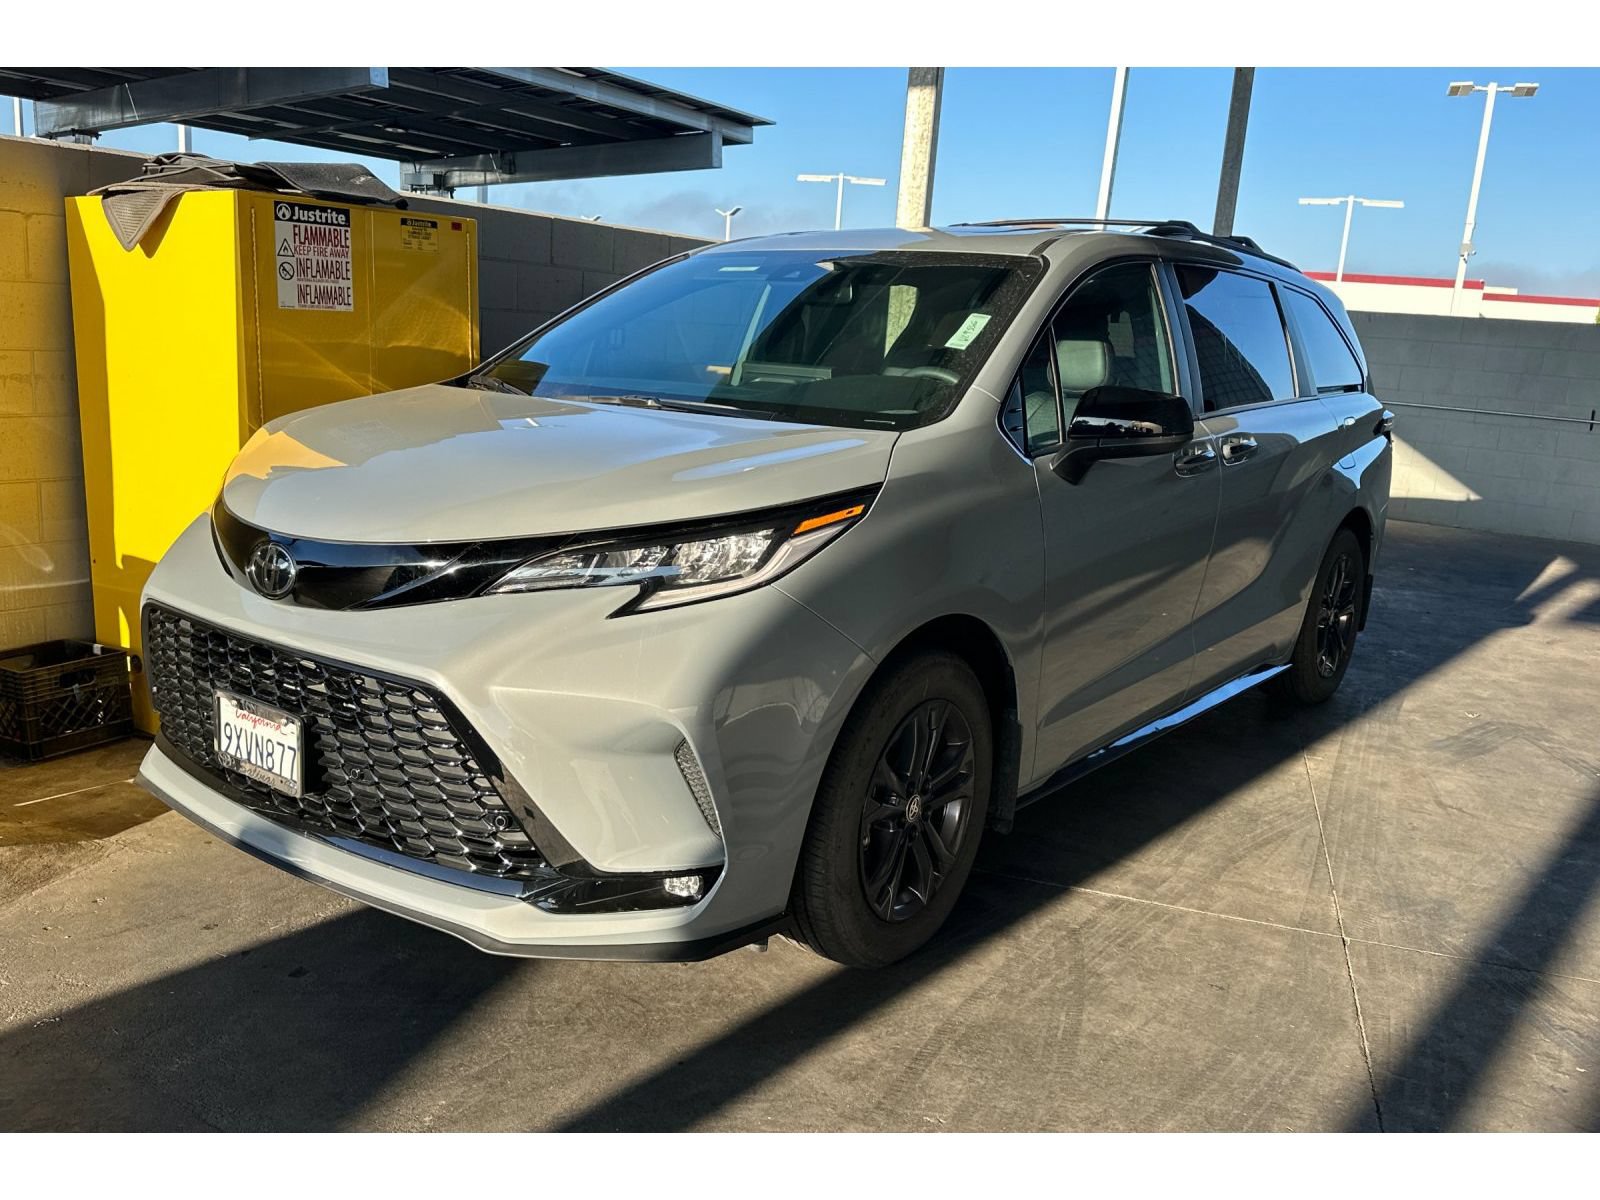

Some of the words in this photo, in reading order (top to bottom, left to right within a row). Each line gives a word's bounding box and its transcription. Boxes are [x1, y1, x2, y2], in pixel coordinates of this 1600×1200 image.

[292, 206, 346, 225] Justrite
[293, 224, 349, 248] FLAMMABLE
[294, 245, 311, 256] KEEP
[313, 246, 328, 257] FIRE
[330, 247, 349, 259] AWAY
[296, 257, 350, 280] INFLAMABLE
[297, 284, 351, 305] INFLAMMABLE
[224, 722, 297, 780] 9XVN877
